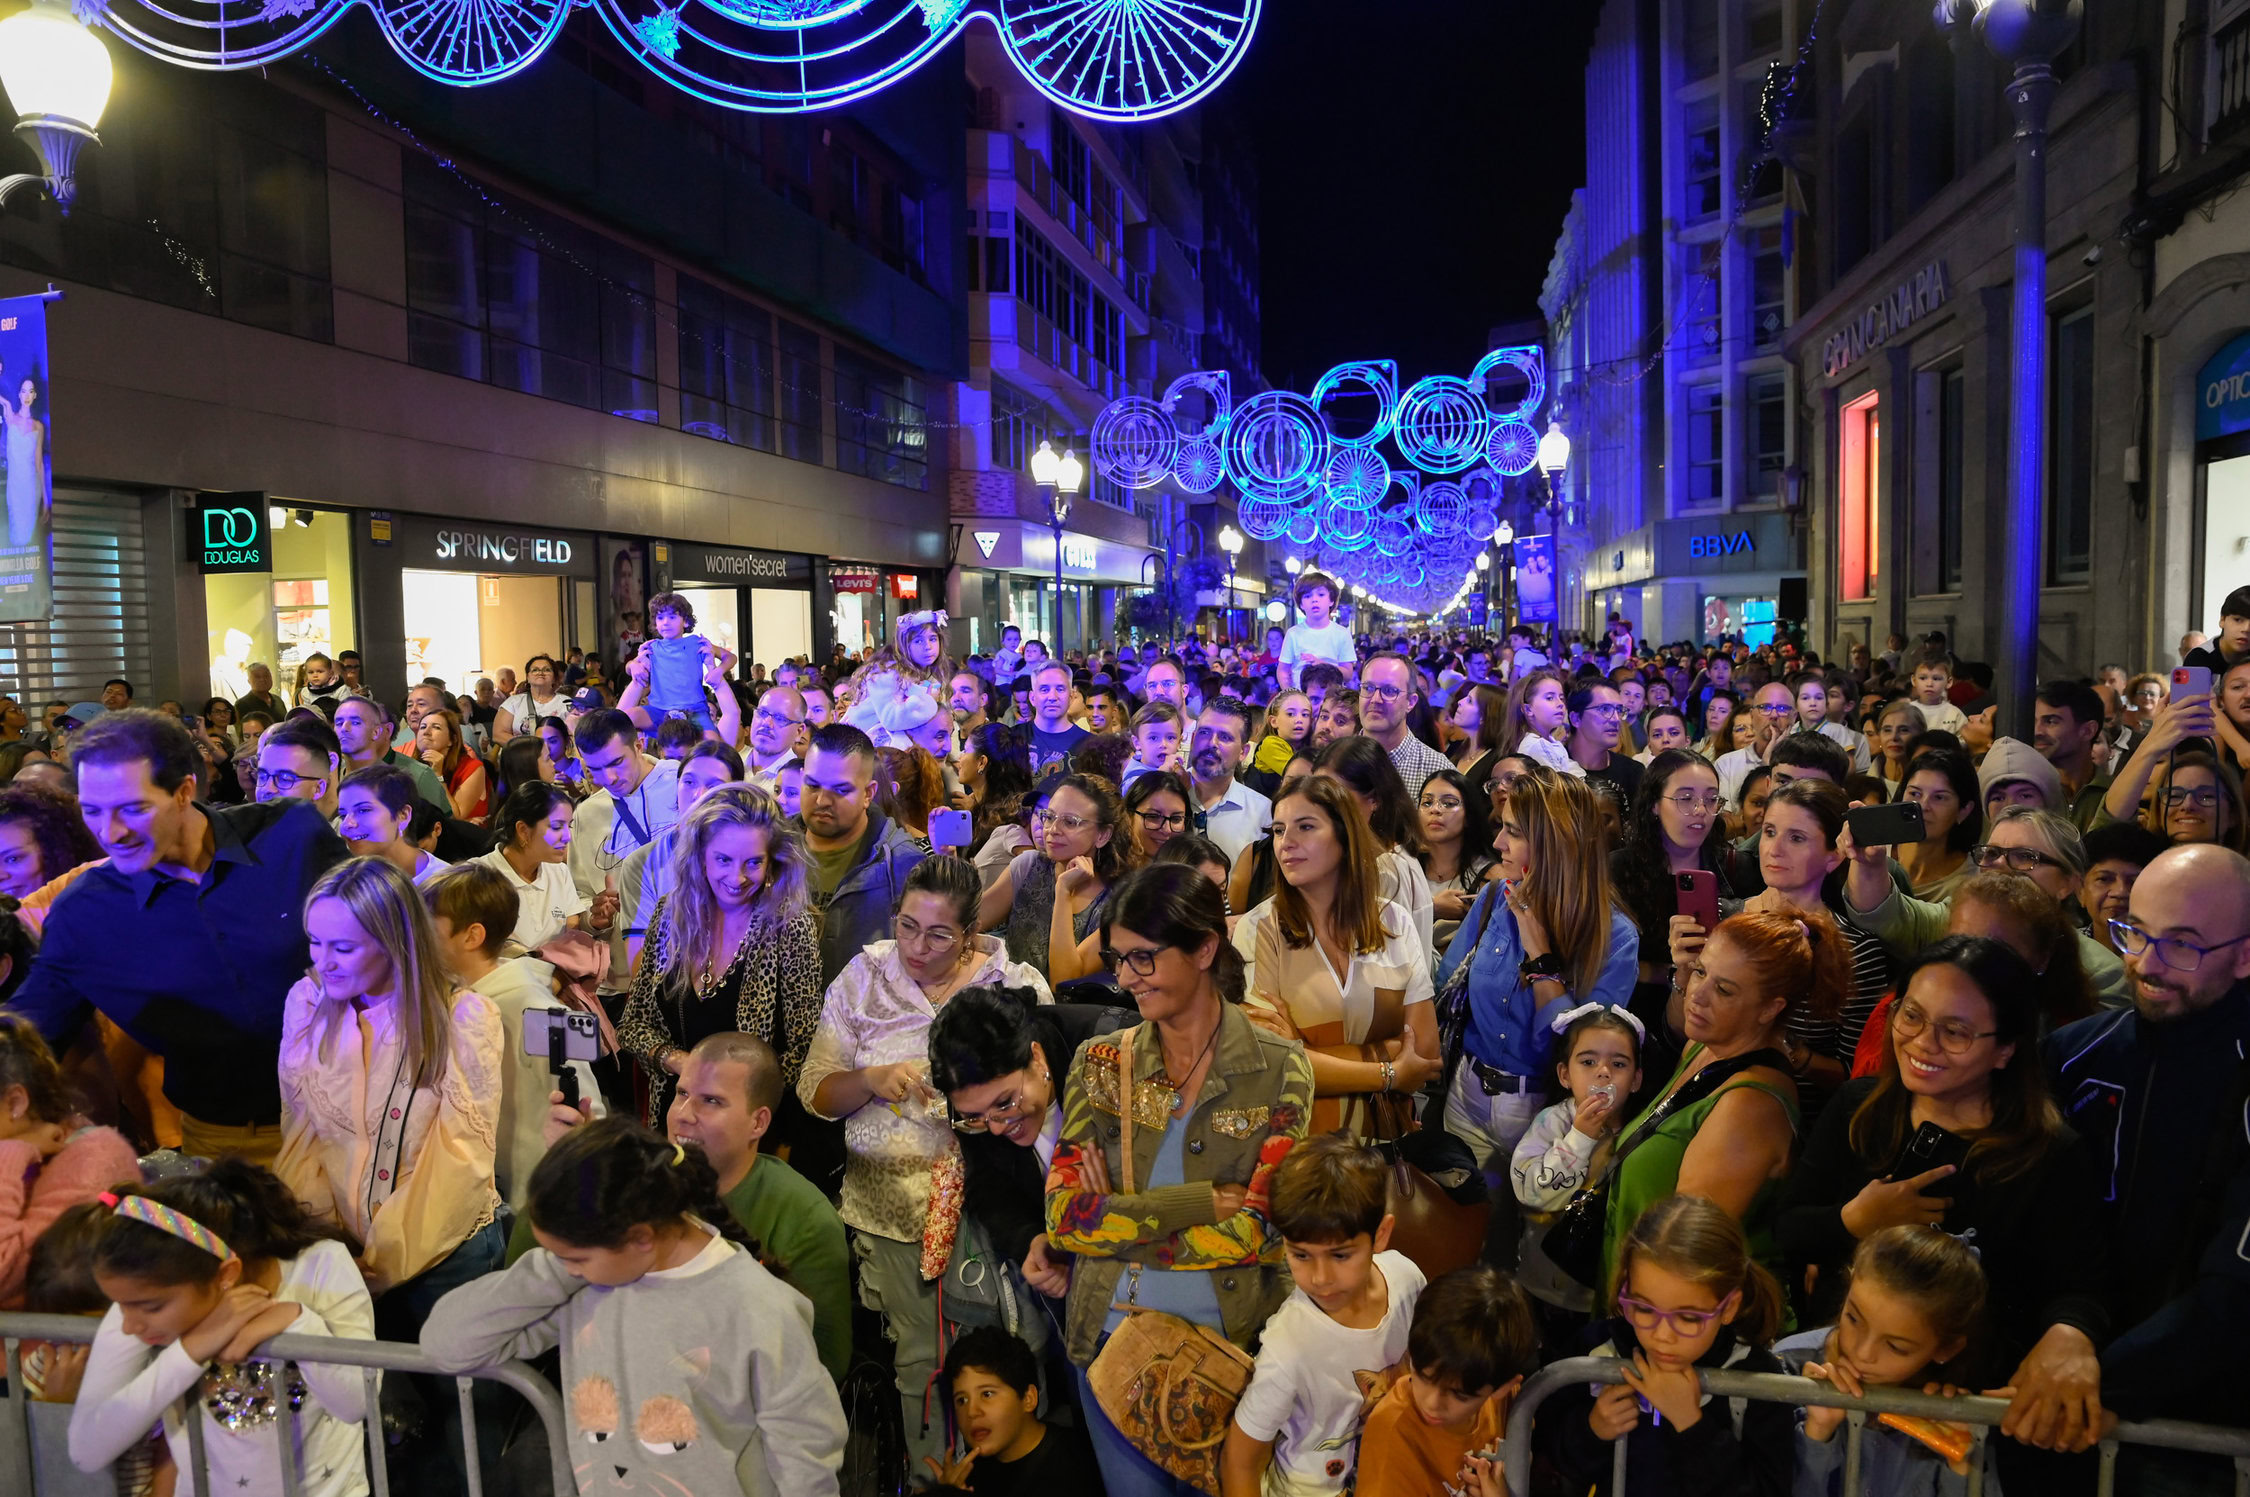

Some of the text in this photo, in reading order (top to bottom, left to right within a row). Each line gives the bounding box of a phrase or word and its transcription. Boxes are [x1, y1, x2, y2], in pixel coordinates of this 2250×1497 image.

[1, 317, 17, 331] GOLF
[1823, 262, 1948, 377] GRAN CANARIA
[436, 530, 571, 563] SPRINGFIELD
[1691, 530, 1753, 558] BBVA
[205, 549, 259, 565] DOUGLAS
[705, 554, 787, 577] women'secret
